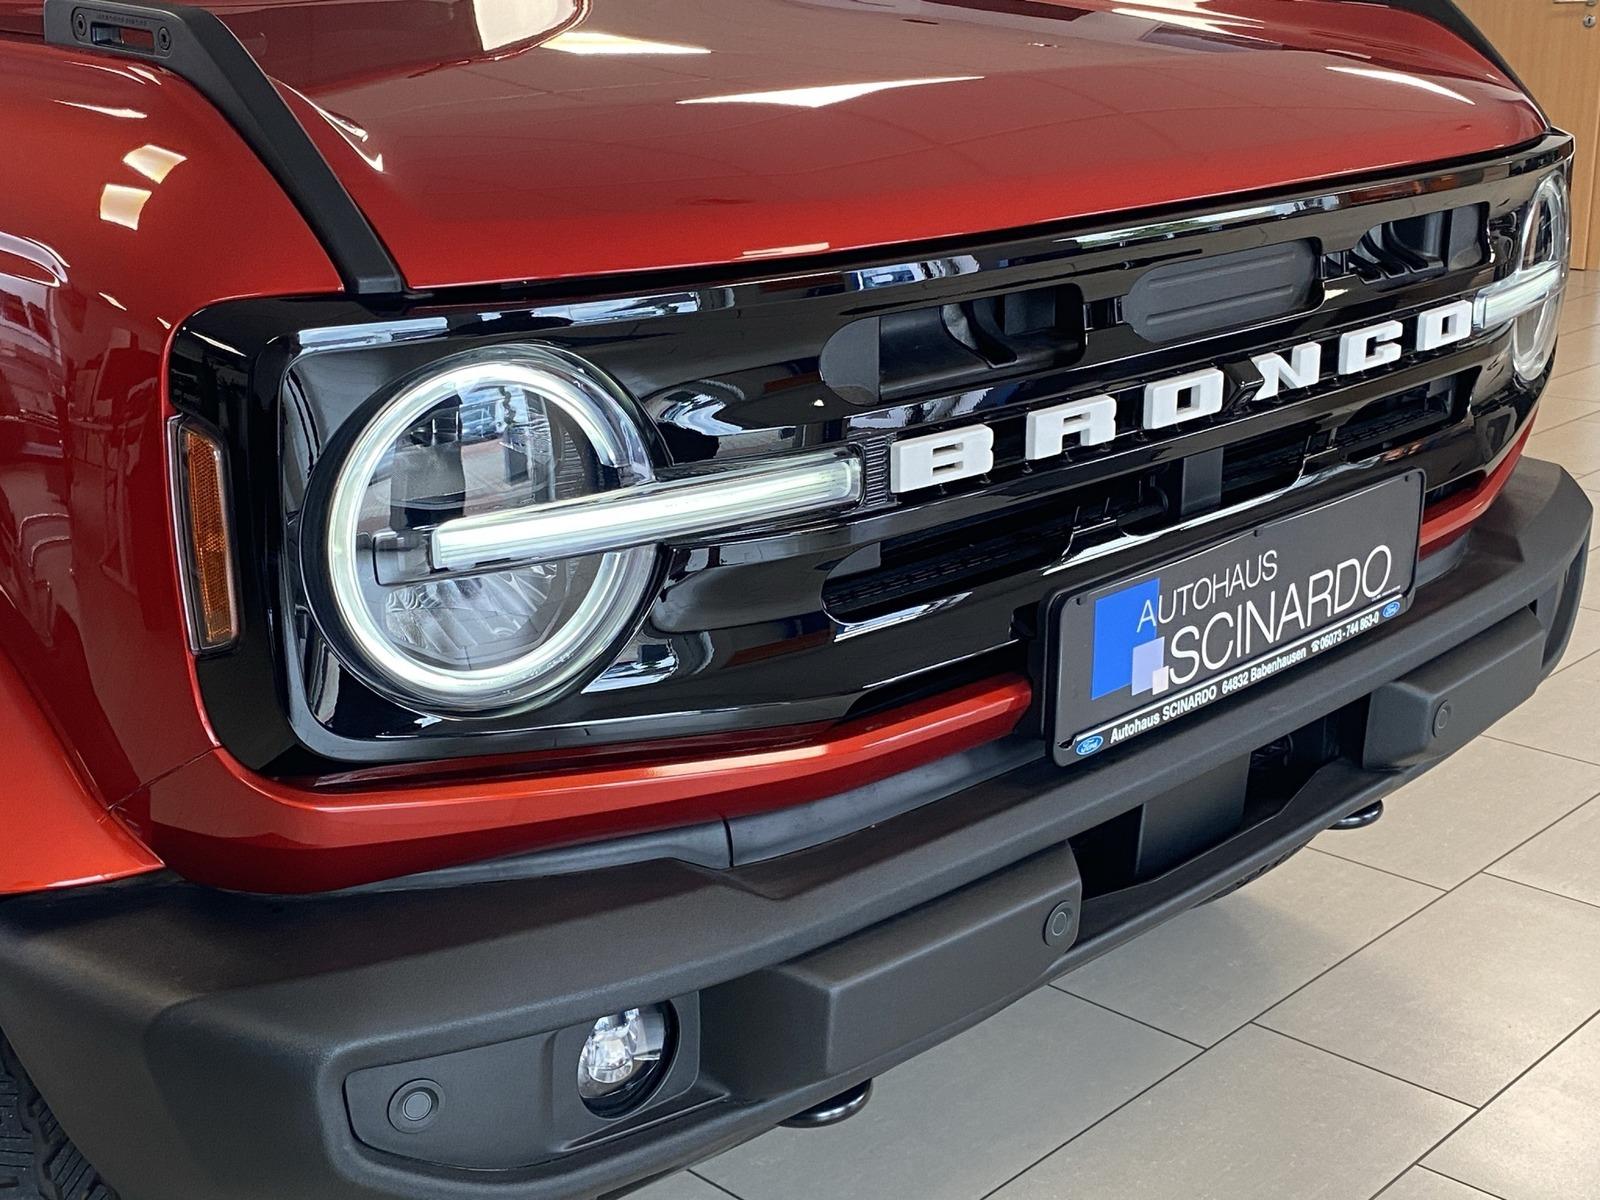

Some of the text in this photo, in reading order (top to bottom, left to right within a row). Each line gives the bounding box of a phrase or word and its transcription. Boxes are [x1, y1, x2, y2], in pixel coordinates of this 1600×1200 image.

[890, 300, 1471, 494] BRONCO
[1136, 550, 1278, 633] AUTOHAUS
[1169, 545, 1392, 685] SCINARDO
[1110, 711, 1160, 744] Autohaus
[1162, 685, 1217, 721] SCINARDO
[1222, 672, 1249, 694] 64832
[1250, 647, 1307, 680] Babenhausen
